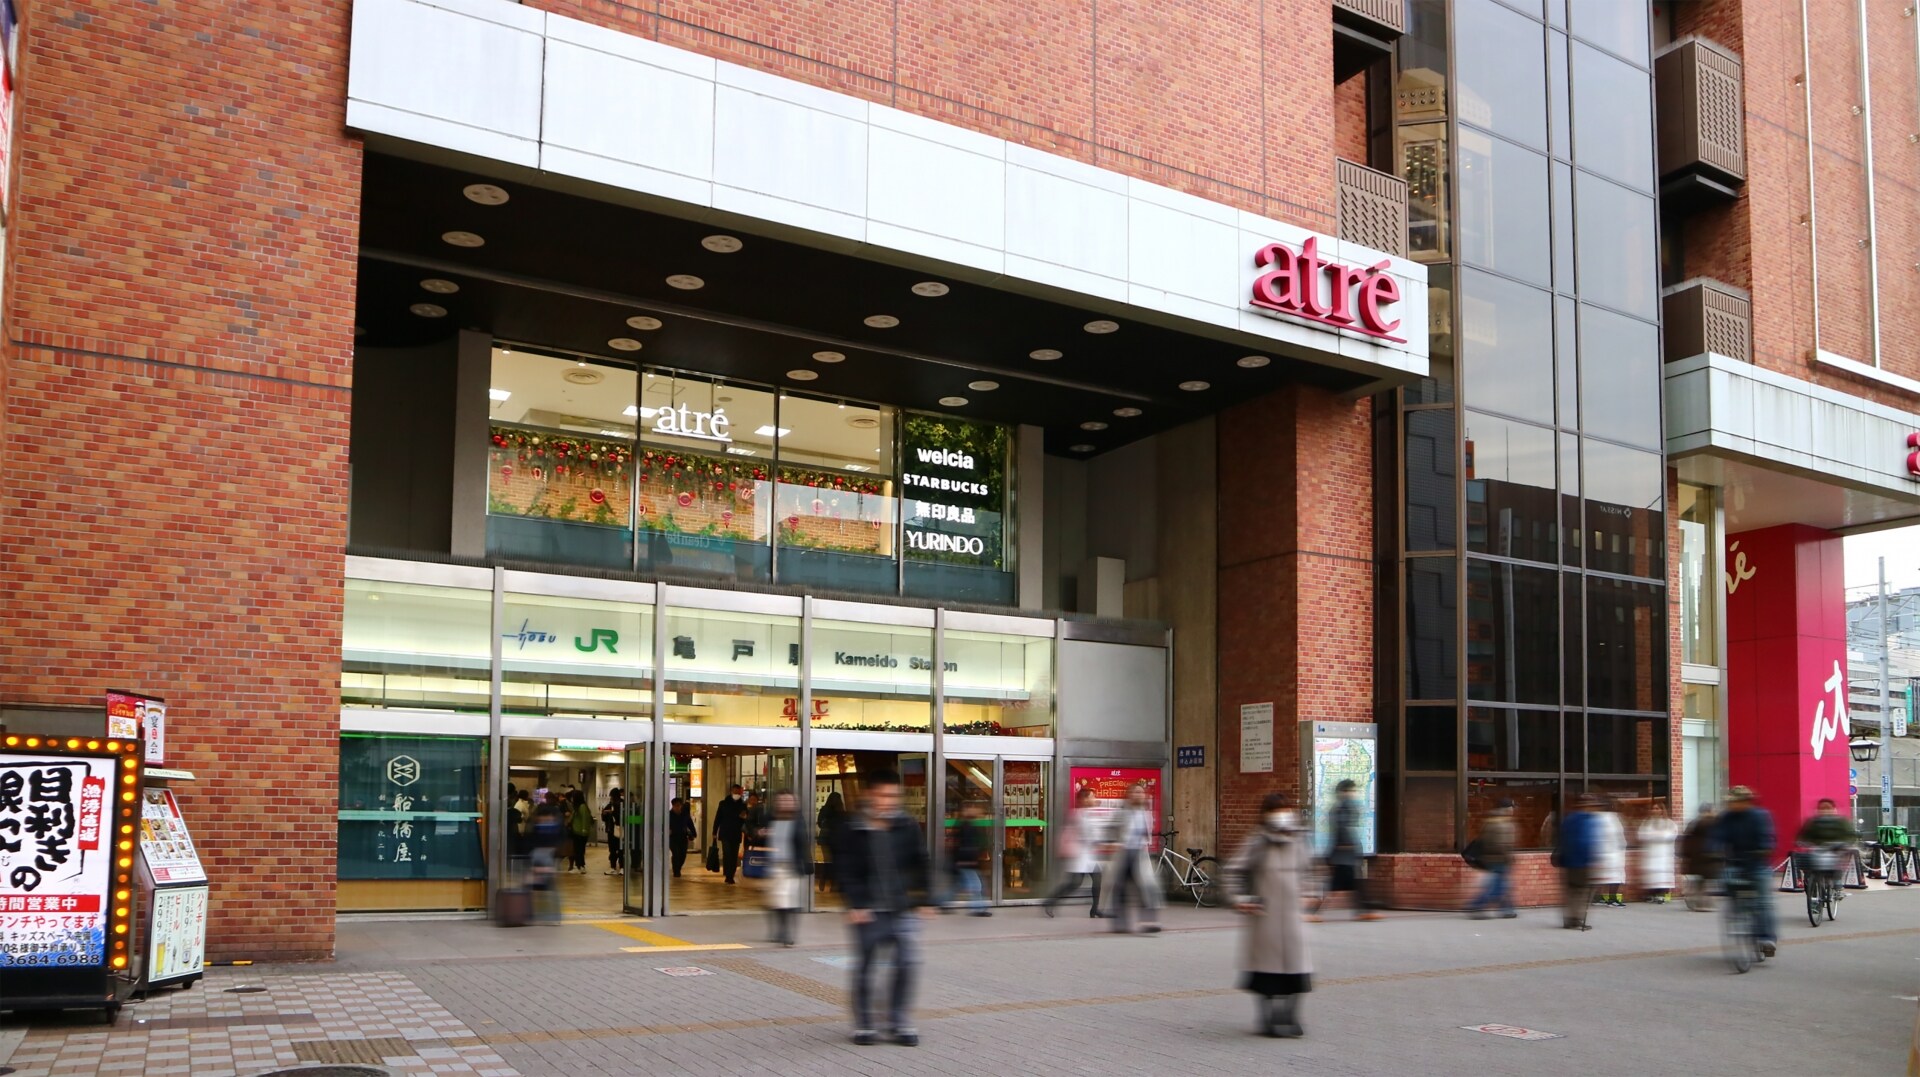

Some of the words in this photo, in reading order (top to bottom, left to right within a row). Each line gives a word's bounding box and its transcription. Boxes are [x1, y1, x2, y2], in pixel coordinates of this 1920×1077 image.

[1252, 236, 1401, 334] atré
[656, 402, 730, 438] atré
[917, 448, 974, 469] welcia
[903, 473, 988, 495] STARBUCKS
[915, 500, 975, 524] 無印良品
[906, 530, 984, 555] YURINDO
[575, 628, 618, 653] JR
[835, 651, 898, 668] Kameido
[909, 656, 958, 672] Staon
